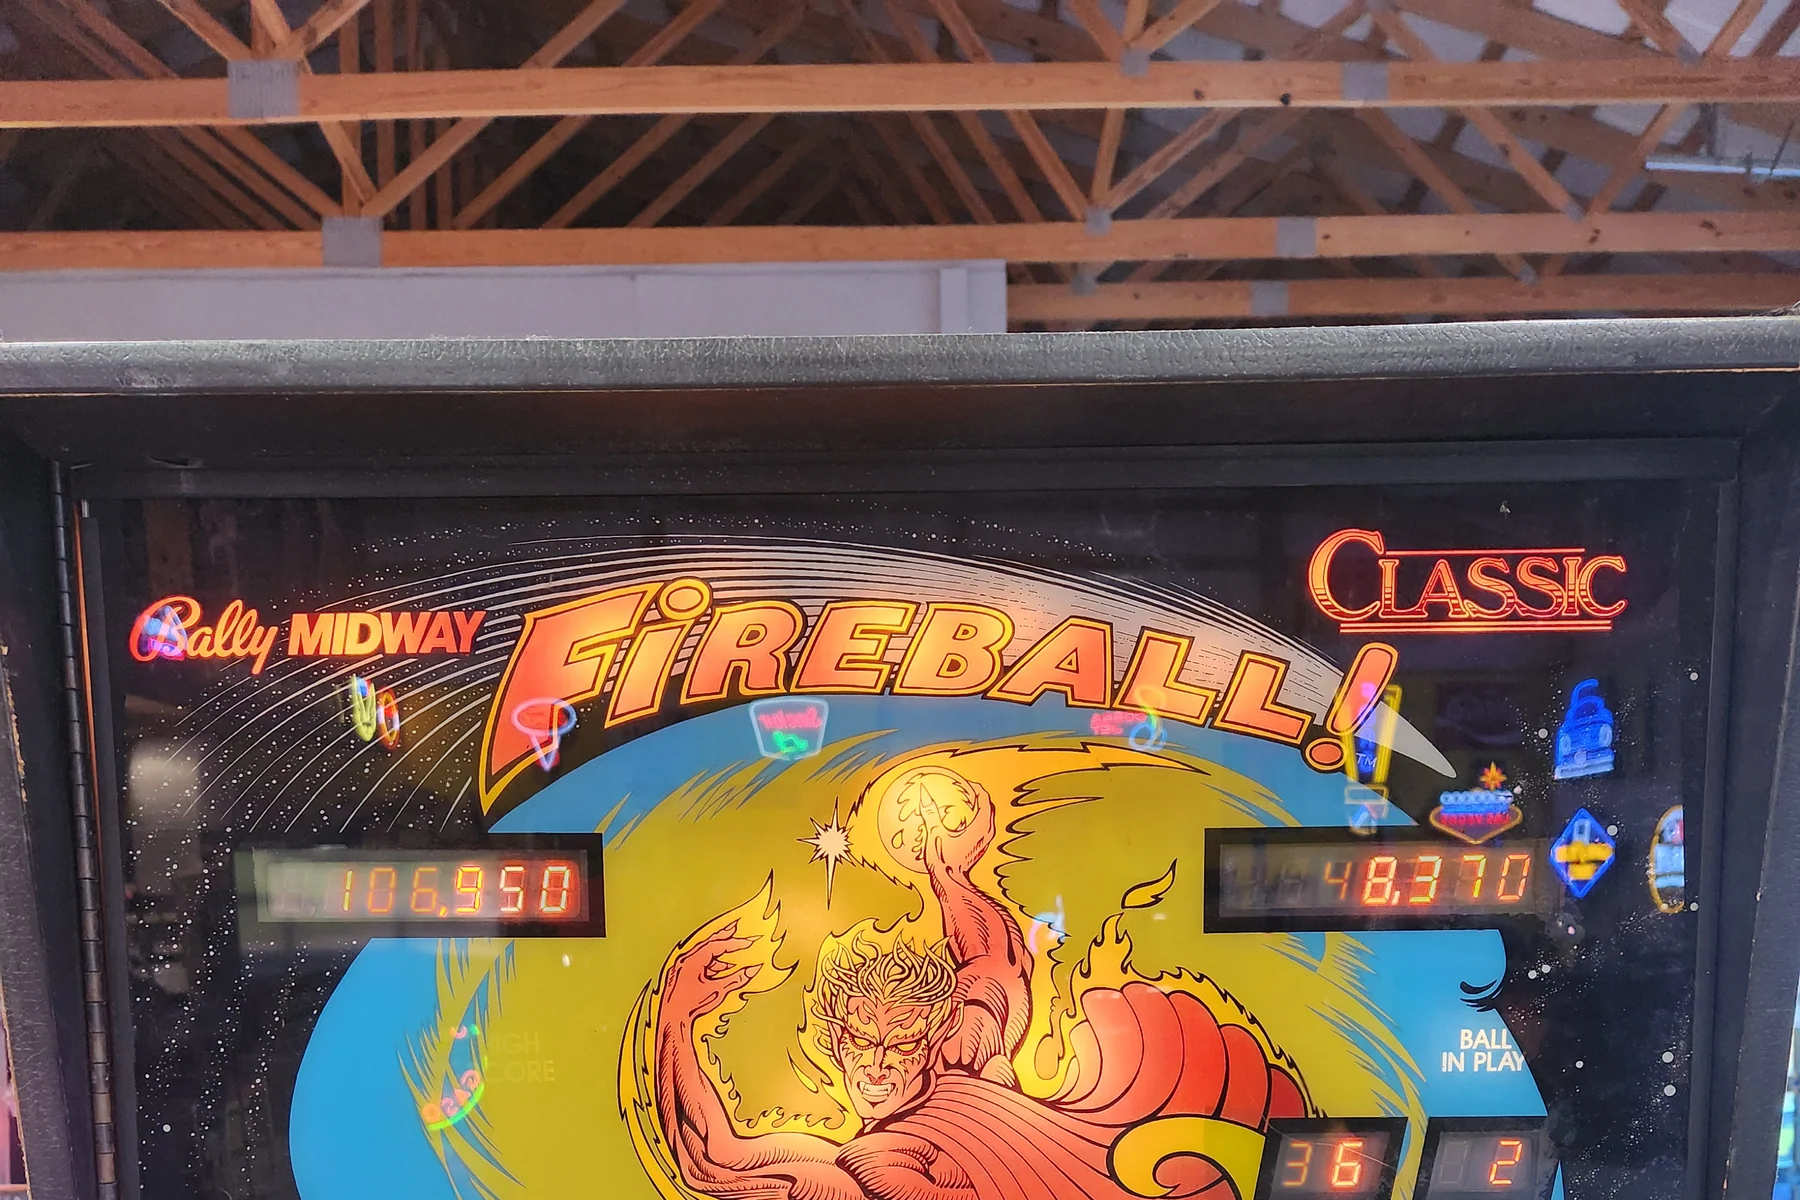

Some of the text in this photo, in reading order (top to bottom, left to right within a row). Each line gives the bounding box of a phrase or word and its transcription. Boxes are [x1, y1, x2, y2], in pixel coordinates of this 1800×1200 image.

[1308, 528, 1628, 621] CLASSIC
[129, 594, 488, 676] Bally MIDWAY
[1355, 752, 1378, 768] TM
[1459, 1028, 1513, 1051] BALL
[485, 1059, 556, 1084] CORE
[1441, 1051, 1525, 1073] IN PLAY
[1488, 1138, 1524, 1186] 2
